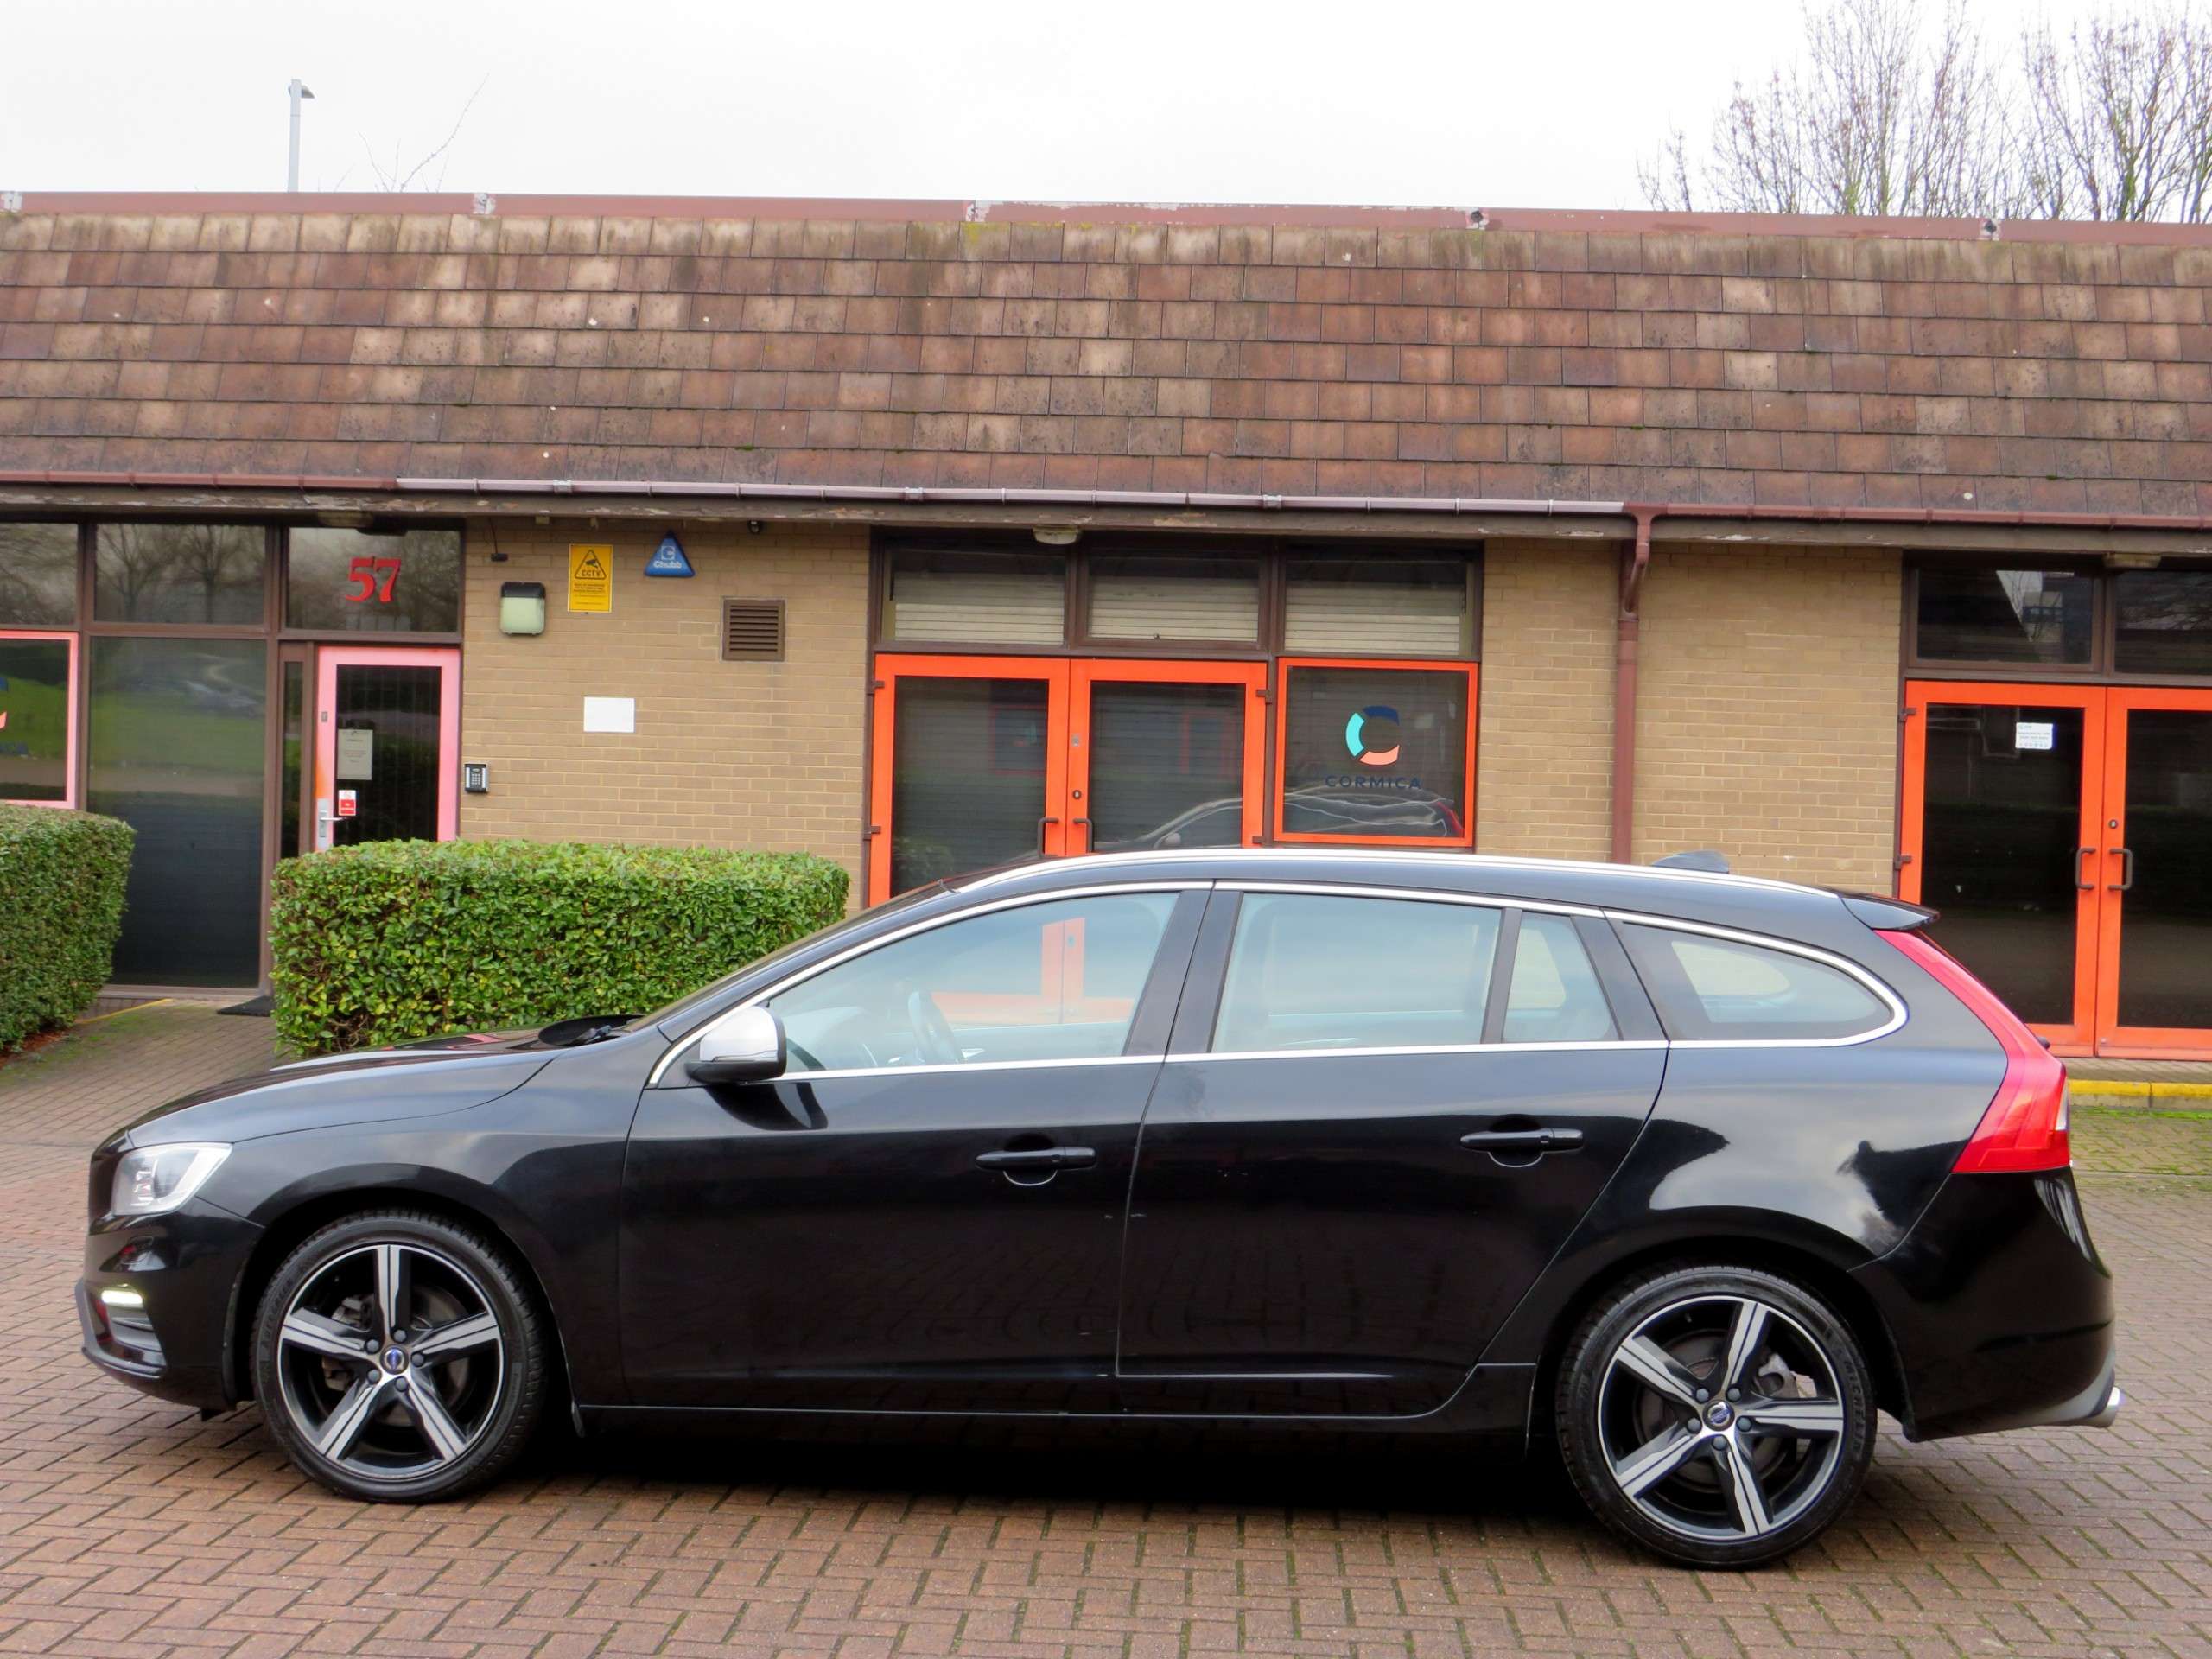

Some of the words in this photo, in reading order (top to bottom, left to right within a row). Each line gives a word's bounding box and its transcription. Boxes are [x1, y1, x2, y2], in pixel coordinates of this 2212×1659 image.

[346, 557, 402, 602] 57
[653, 560, 682, 569] Chubb
[1325, 775, 1422, 790] CORMICA
[1842, 1360, 1866, 1455] MICHELIN
